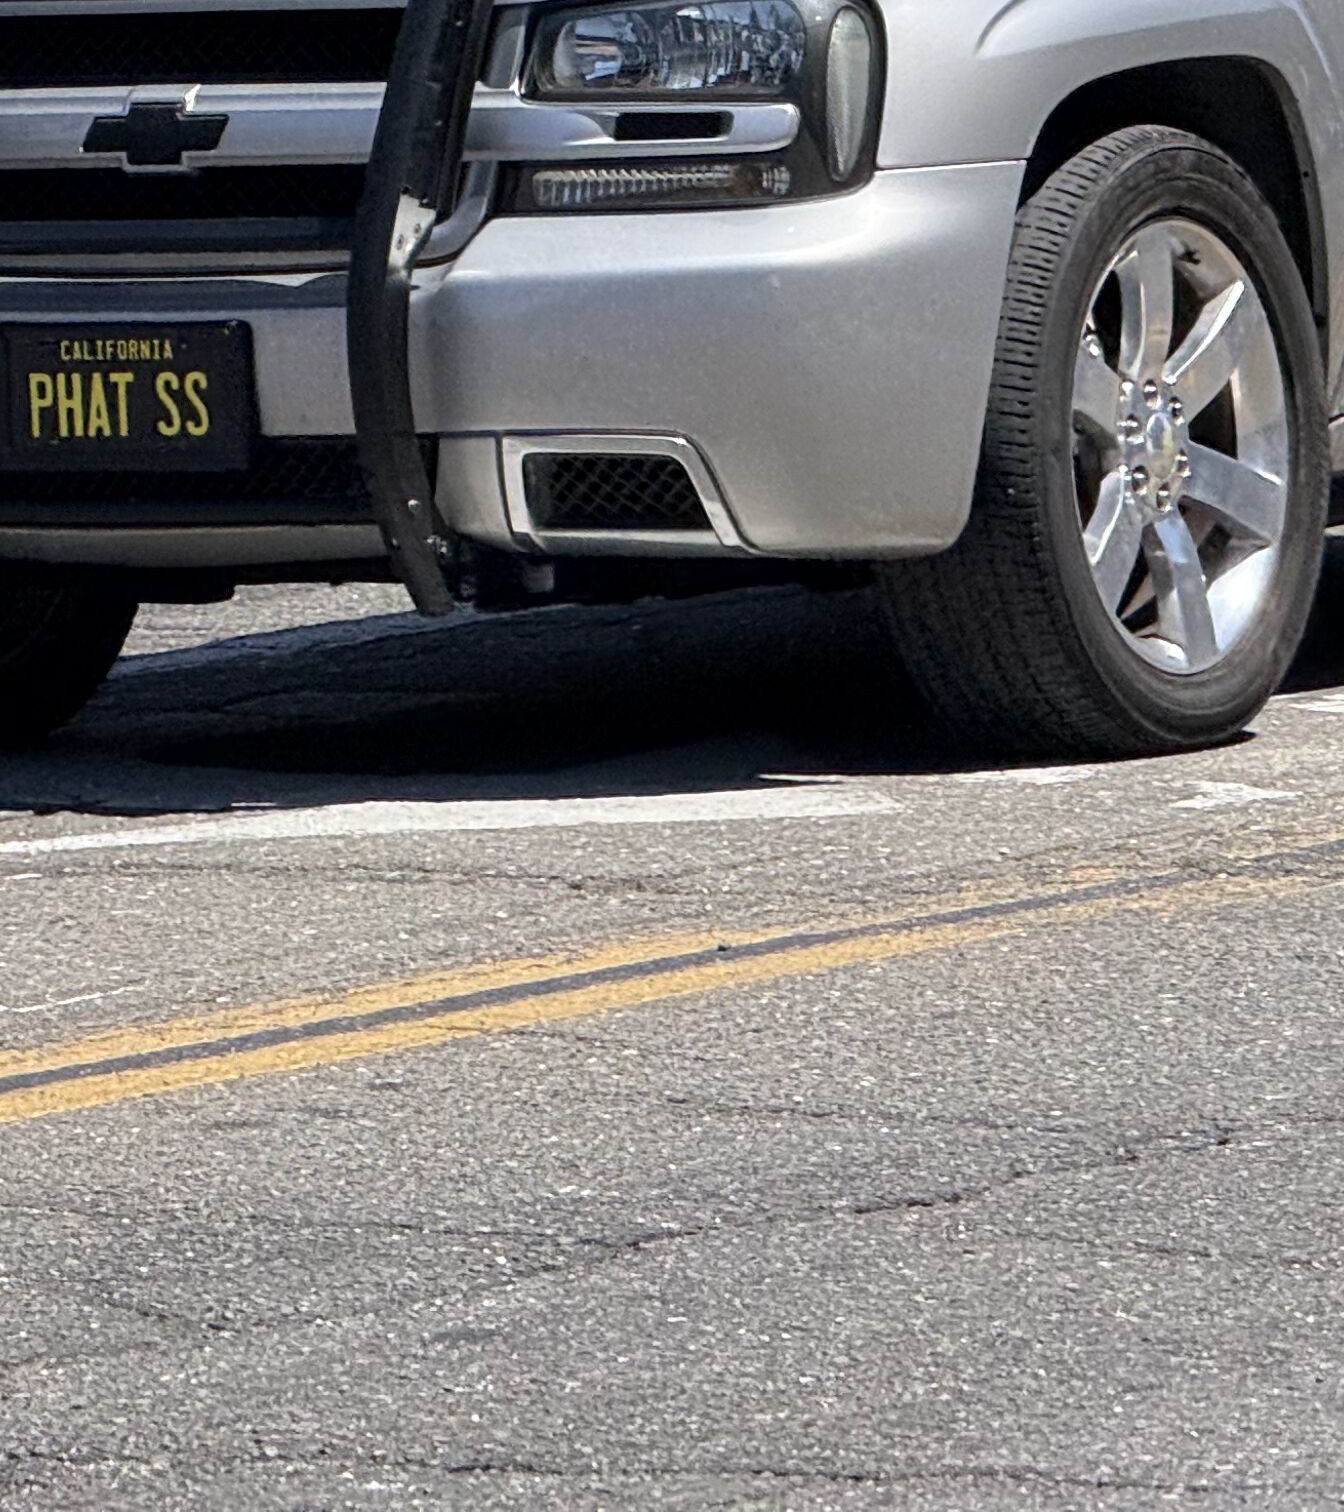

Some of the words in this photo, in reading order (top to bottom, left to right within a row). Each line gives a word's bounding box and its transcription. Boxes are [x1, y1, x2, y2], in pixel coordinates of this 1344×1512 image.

[60, 340, 174, 361] CALIFORNIA
[28, 372, 134, 438] PHAT
[155, 371, 210, 437] SS
